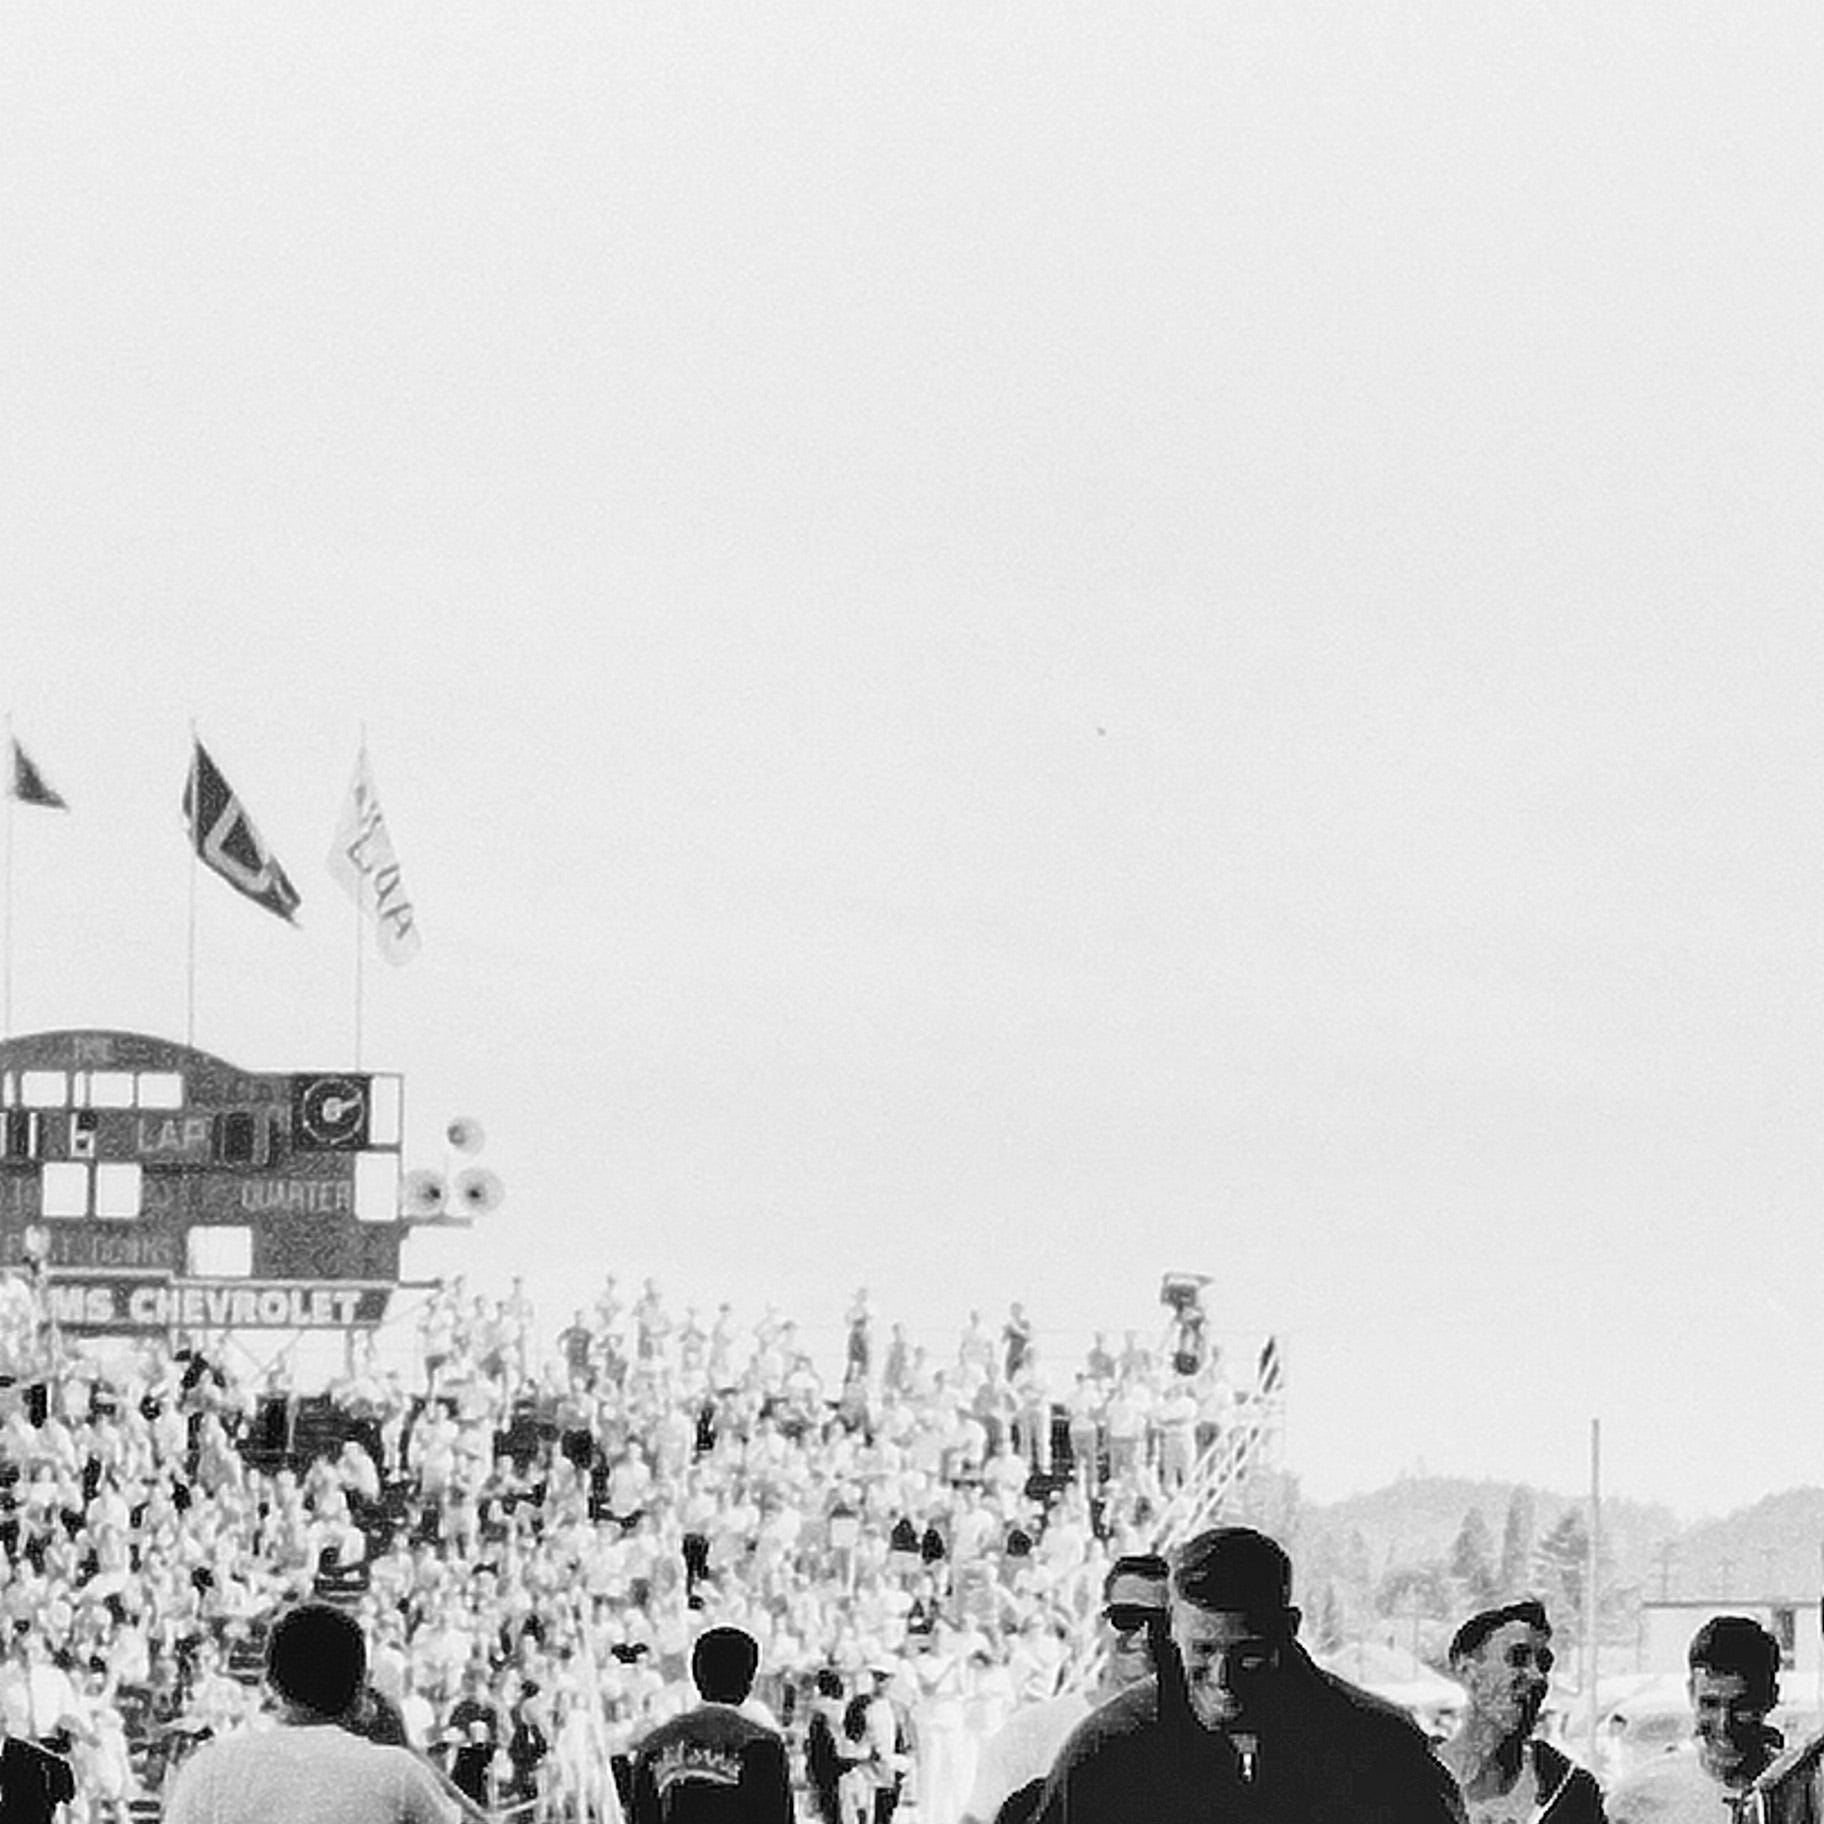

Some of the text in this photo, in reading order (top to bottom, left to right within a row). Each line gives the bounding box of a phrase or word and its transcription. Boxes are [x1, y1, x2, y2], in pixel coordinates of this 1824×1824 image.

[136, 1117, 209, 1153] LAP
[240, 1180, 353, 1212] QUARTER
[47, 1286, 363, 1325] MS CHEVROLET
